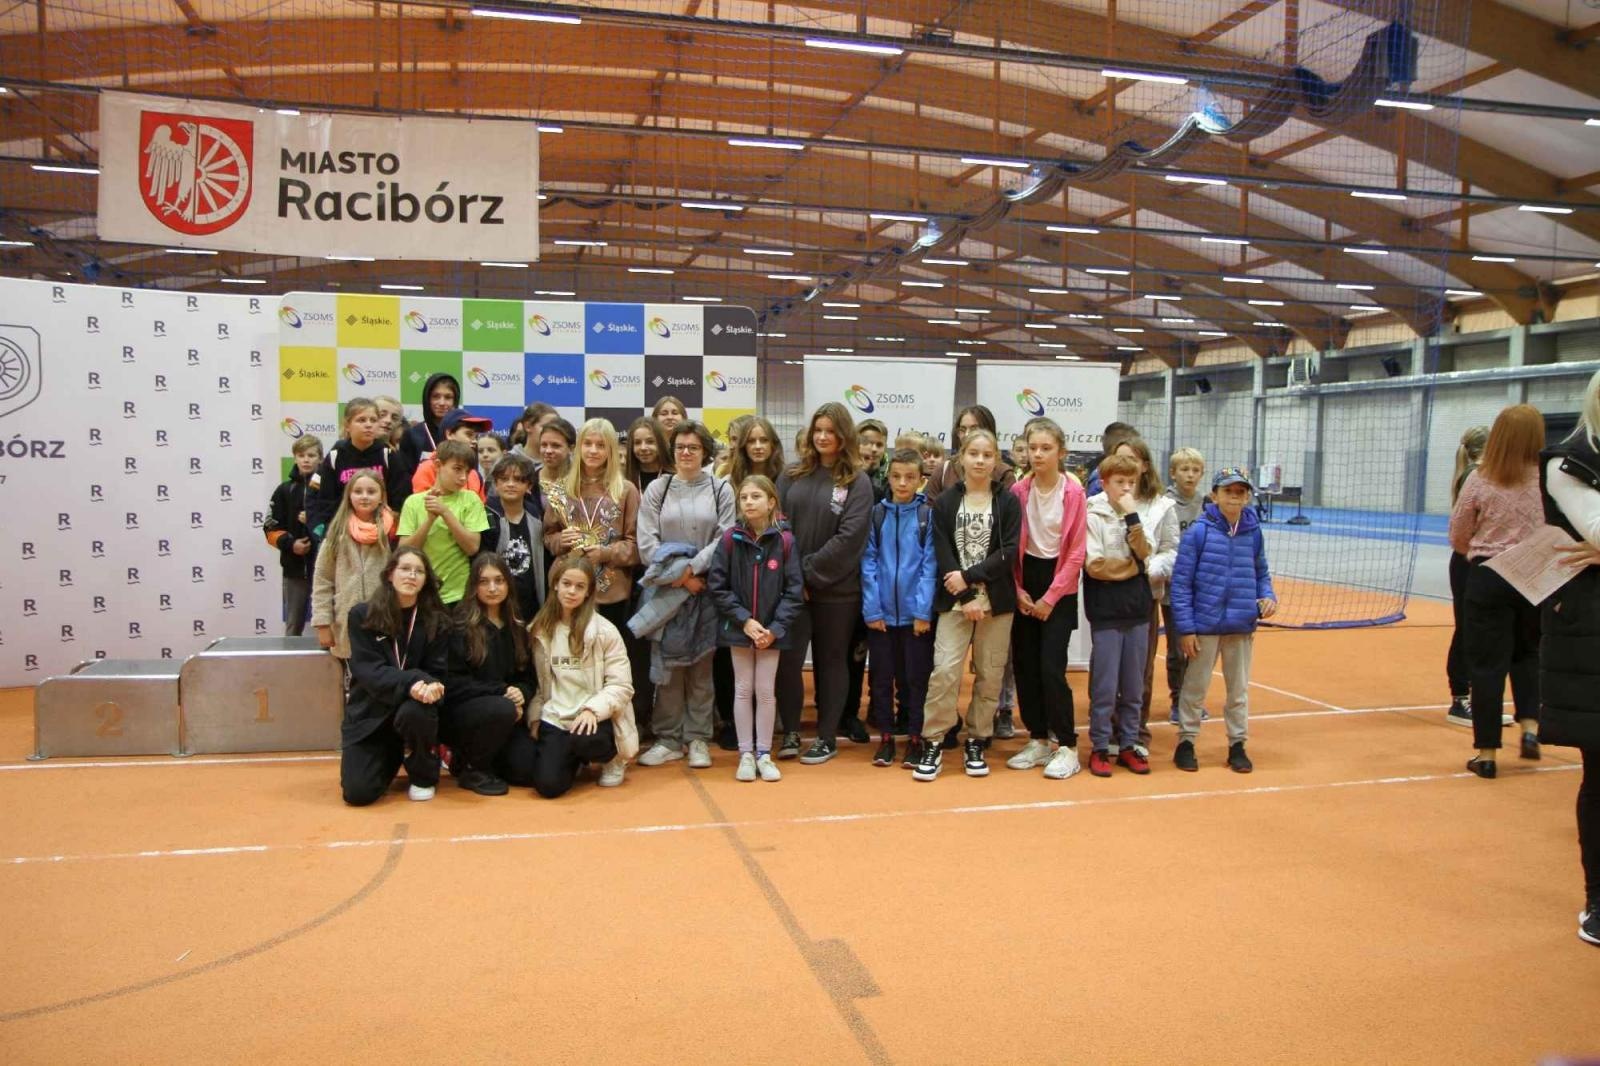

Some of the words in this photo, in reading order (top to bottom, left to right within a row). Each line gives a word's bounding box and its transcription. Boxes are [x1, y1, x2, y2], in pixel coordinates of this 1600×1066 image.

[280, 147, 399, 175] MIASTO
[277, 177, 505, 225] Racibórz
[53, 287, 64, 298] R
[122, 292, 133, 303] R
[187, 296, 198, 307] R
[250, 298, 260, 309] R
[88, 316, 99, 328] R
[304, 313, 334, 322] ZSOMS
[429, 317, 459, 327] ZSOMS
[154, 321, 165, 332] R
[218, 323, 228, 335] R
[552, 321, 581, 330] ZSOMS
[671, 323, 700, 332] ZSOMS
[123, 346, 134, 358] R
[188, 349, 199, 361] R
[251, 351, 261, 362] R
[88, 372, 100, 384] R
[366, 370, 397, 379] ZSOMS
[491, 373, 520, 382] ZSOMS
[612, 375, 641, 384] ZSOMS
[156, 375, 166, 387] R
[219, 377, 229, 388] R
[728, 377, 755, 386] ZSOMS
[876, 393, 915, 404] ZSOMS
[1047, 397, 1083, 407] ZSOMS
[124, 401, 135, 413] R
[189, 403, 200, 415] R
[252, 404, 262, 415] R
[305, 423, 336, 433] ZSOMS
[90, 429, 101, 441] R
[156, 430, 167, 442] R
[220, 431, 230, 442] R
[125, 457, 136, 469] R
[190, 458, 201, 469] R
[252, 458, 262, 469] R
[91, 485, 102, 497] R
[157, 485, 168, 496] R
[221, 485, 231, 496] R
[58, 513, 70, 525] R
[126, 513, 138, 524] R
[191, 512, 202, 524] R
[253, 512, 263, 523] R
[22, 543, 35, 554] R
[92, 541, 104, 553] R
[159, 540, 170, 551] R
[222, 539, 232, 550] R
[60, 570, 72, 581] R
[128, 568, 139, 579] R
[192, 566, 203, 578] R
[254, 565, 264, 577] R
[94, 596, 105, 608] R
[160, 595, 171, 605] R
[223, 593, 234, 604] R
[24, 599, 36, 611] R
[129, 622, 140, 634] R
[194, 620, 204, 631] R
[256, 619, 266, 629] R
[62, 625, 73, 637] R
[161, 648, 172, 658] R
[26, 655, 37, 666] R
[254, 688, 275, 722] 1
[95, 702, 123, 737] 2
